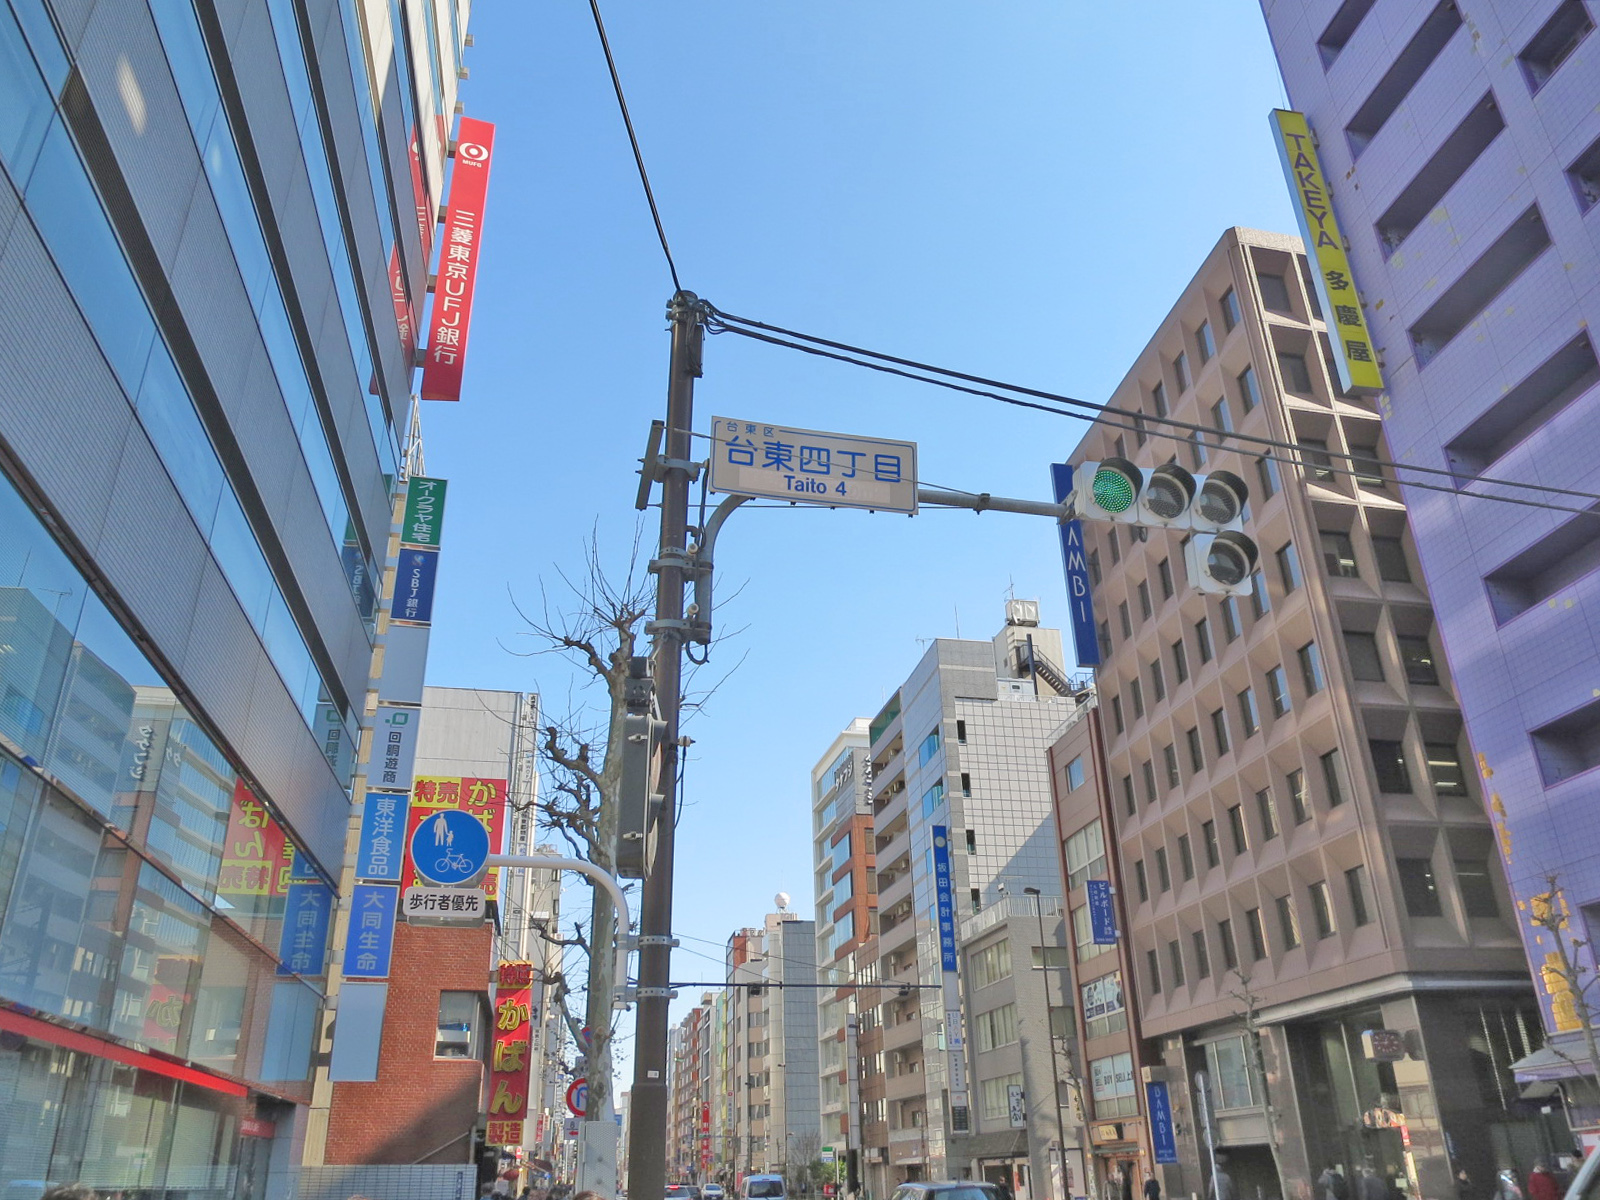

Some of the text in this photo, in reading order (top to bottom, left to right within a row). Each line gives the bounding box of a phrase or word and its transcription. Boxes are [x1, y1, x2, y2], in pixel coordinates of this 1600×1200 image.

[462, 159, 482, 168] MUFG
[1286, 133, 1371, 363] TAKEYA 多慶屋
[434, 209, 475, 366] 三菱東京UFJ銀行
[726, 421, 775, 437] 台東区
[725, 435, 901, 483] 台東四丁目
[783, 475, 847, 496] Taito 4
[412, 481, 437, 543] オークラヤ住宅
[405, 569, 421, 618] SBJ銀行
[1068, 526, 1086, 623] AMBI
[383, 731, 402, 784] 回胴遊商
[414, 779, 460, 804] 特売
[368, 797, 397, 876] 東洋食品
[409, 893, 479, 912] 歩行者優先
[356, 891, 384, 971] 大同生命
[490, 998, 529, 1115] かばん
[488, 1122, 522, 1144] 製造
[1154, 1087, 1167, 1145] BAMBI
